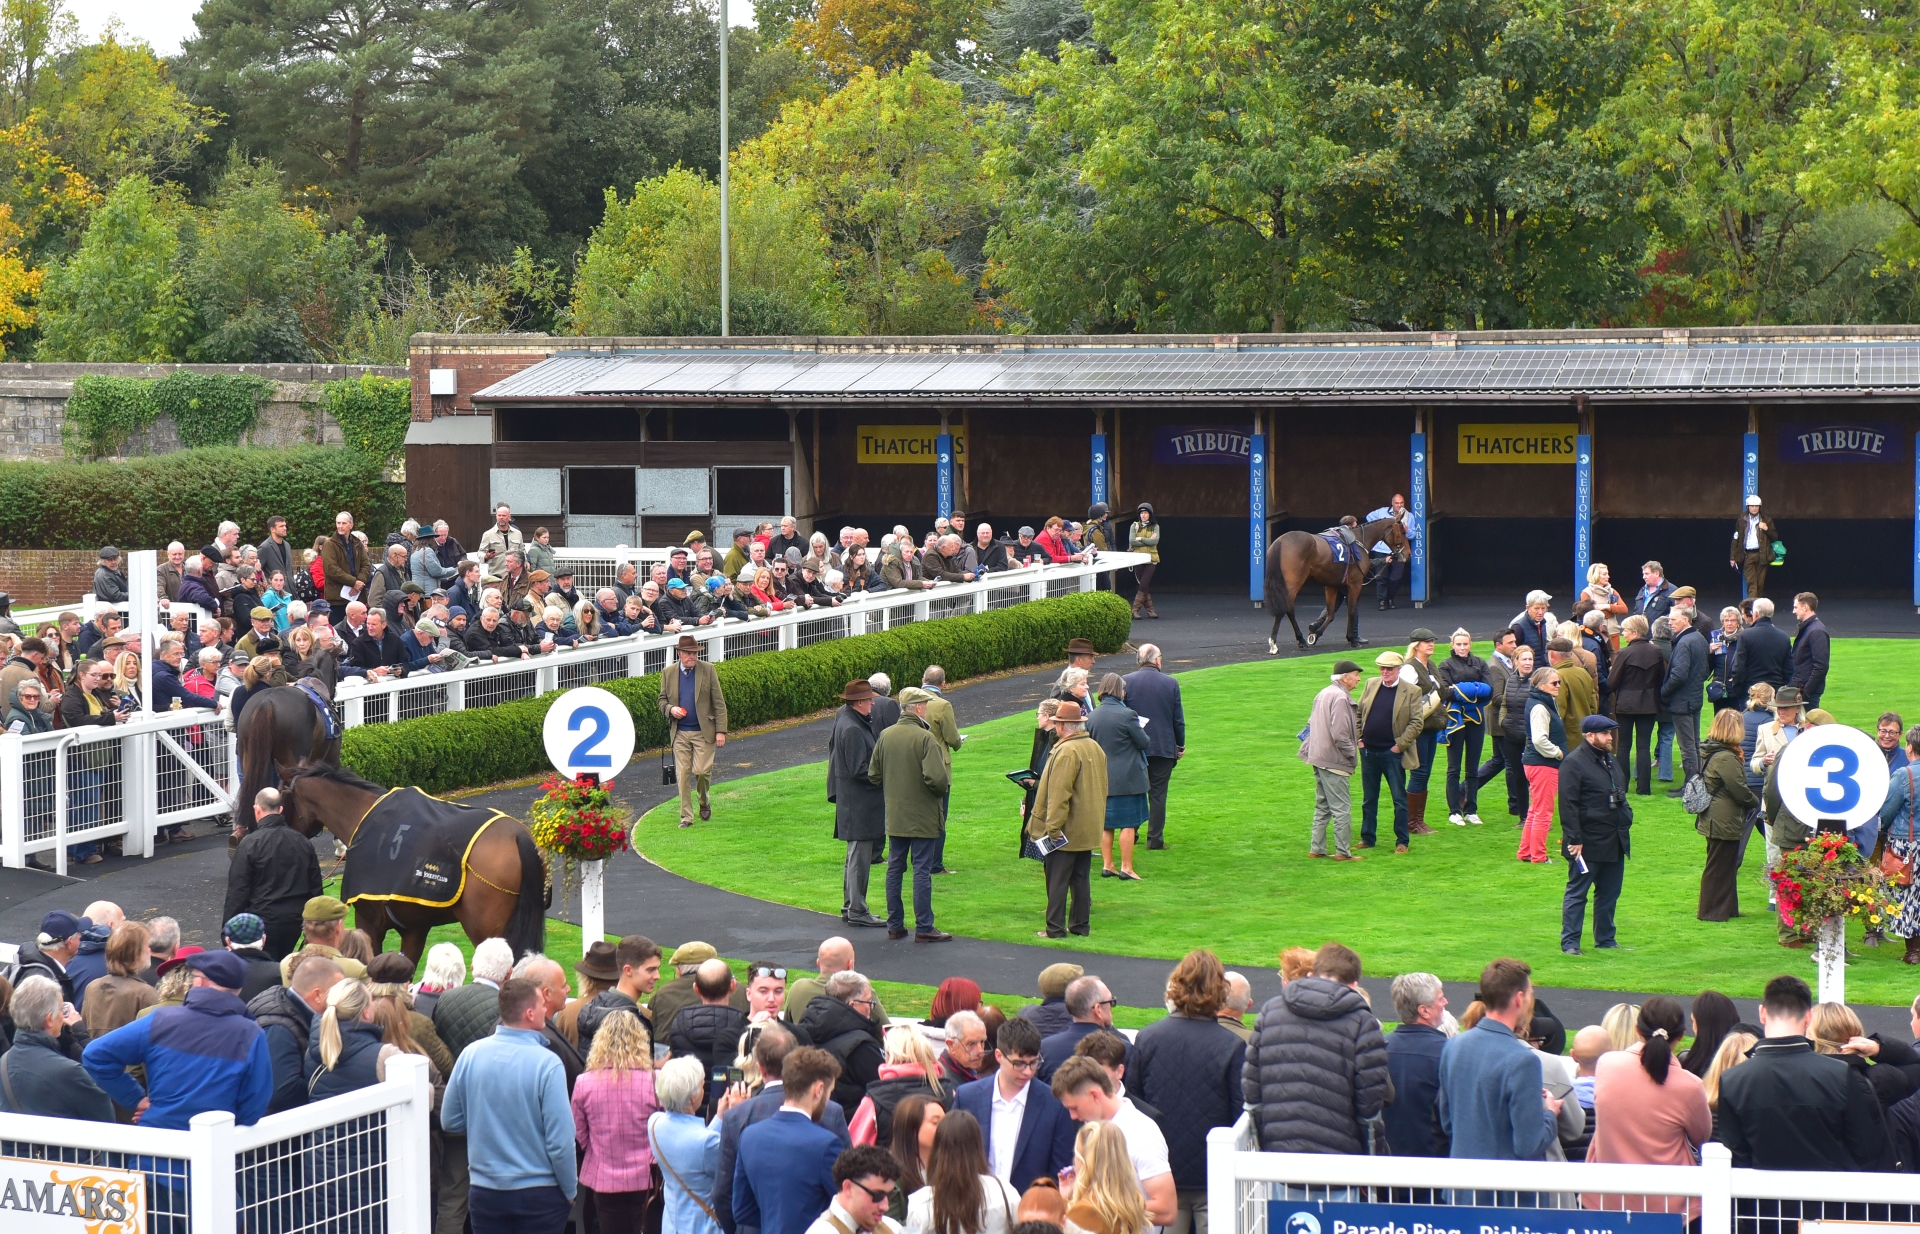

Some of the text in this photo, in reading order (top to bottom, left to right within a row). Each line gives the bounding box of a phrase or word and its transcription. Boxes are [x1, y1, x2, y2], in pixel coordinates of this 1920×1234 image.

[862, 436, 965, 455] THATCHS
[1171, 433, 1251, 456] TRIBUTE
[1463, 435, 1574, 454] THATCHERS
[1798, 430, 1885, 454] TRIBUTE
[940, 469, 949, 517] NEWTON
[1094, 468, 1103, 504] NEWT
[1746, 468, 1756, 496] NEW
[1253, 469, 1262, 565] NEWTON ABBOT
[1414, 468, 1423, 565] NEWTON ABBOT
[1578, 470, 1588, 568] NEWTON ABBOT
[1336, 543, 1345, 562] 2
[567, 705, 612, 768] 2
[1804, 744, 1861, 815] 3
[389, 824, 411, 860] 5
